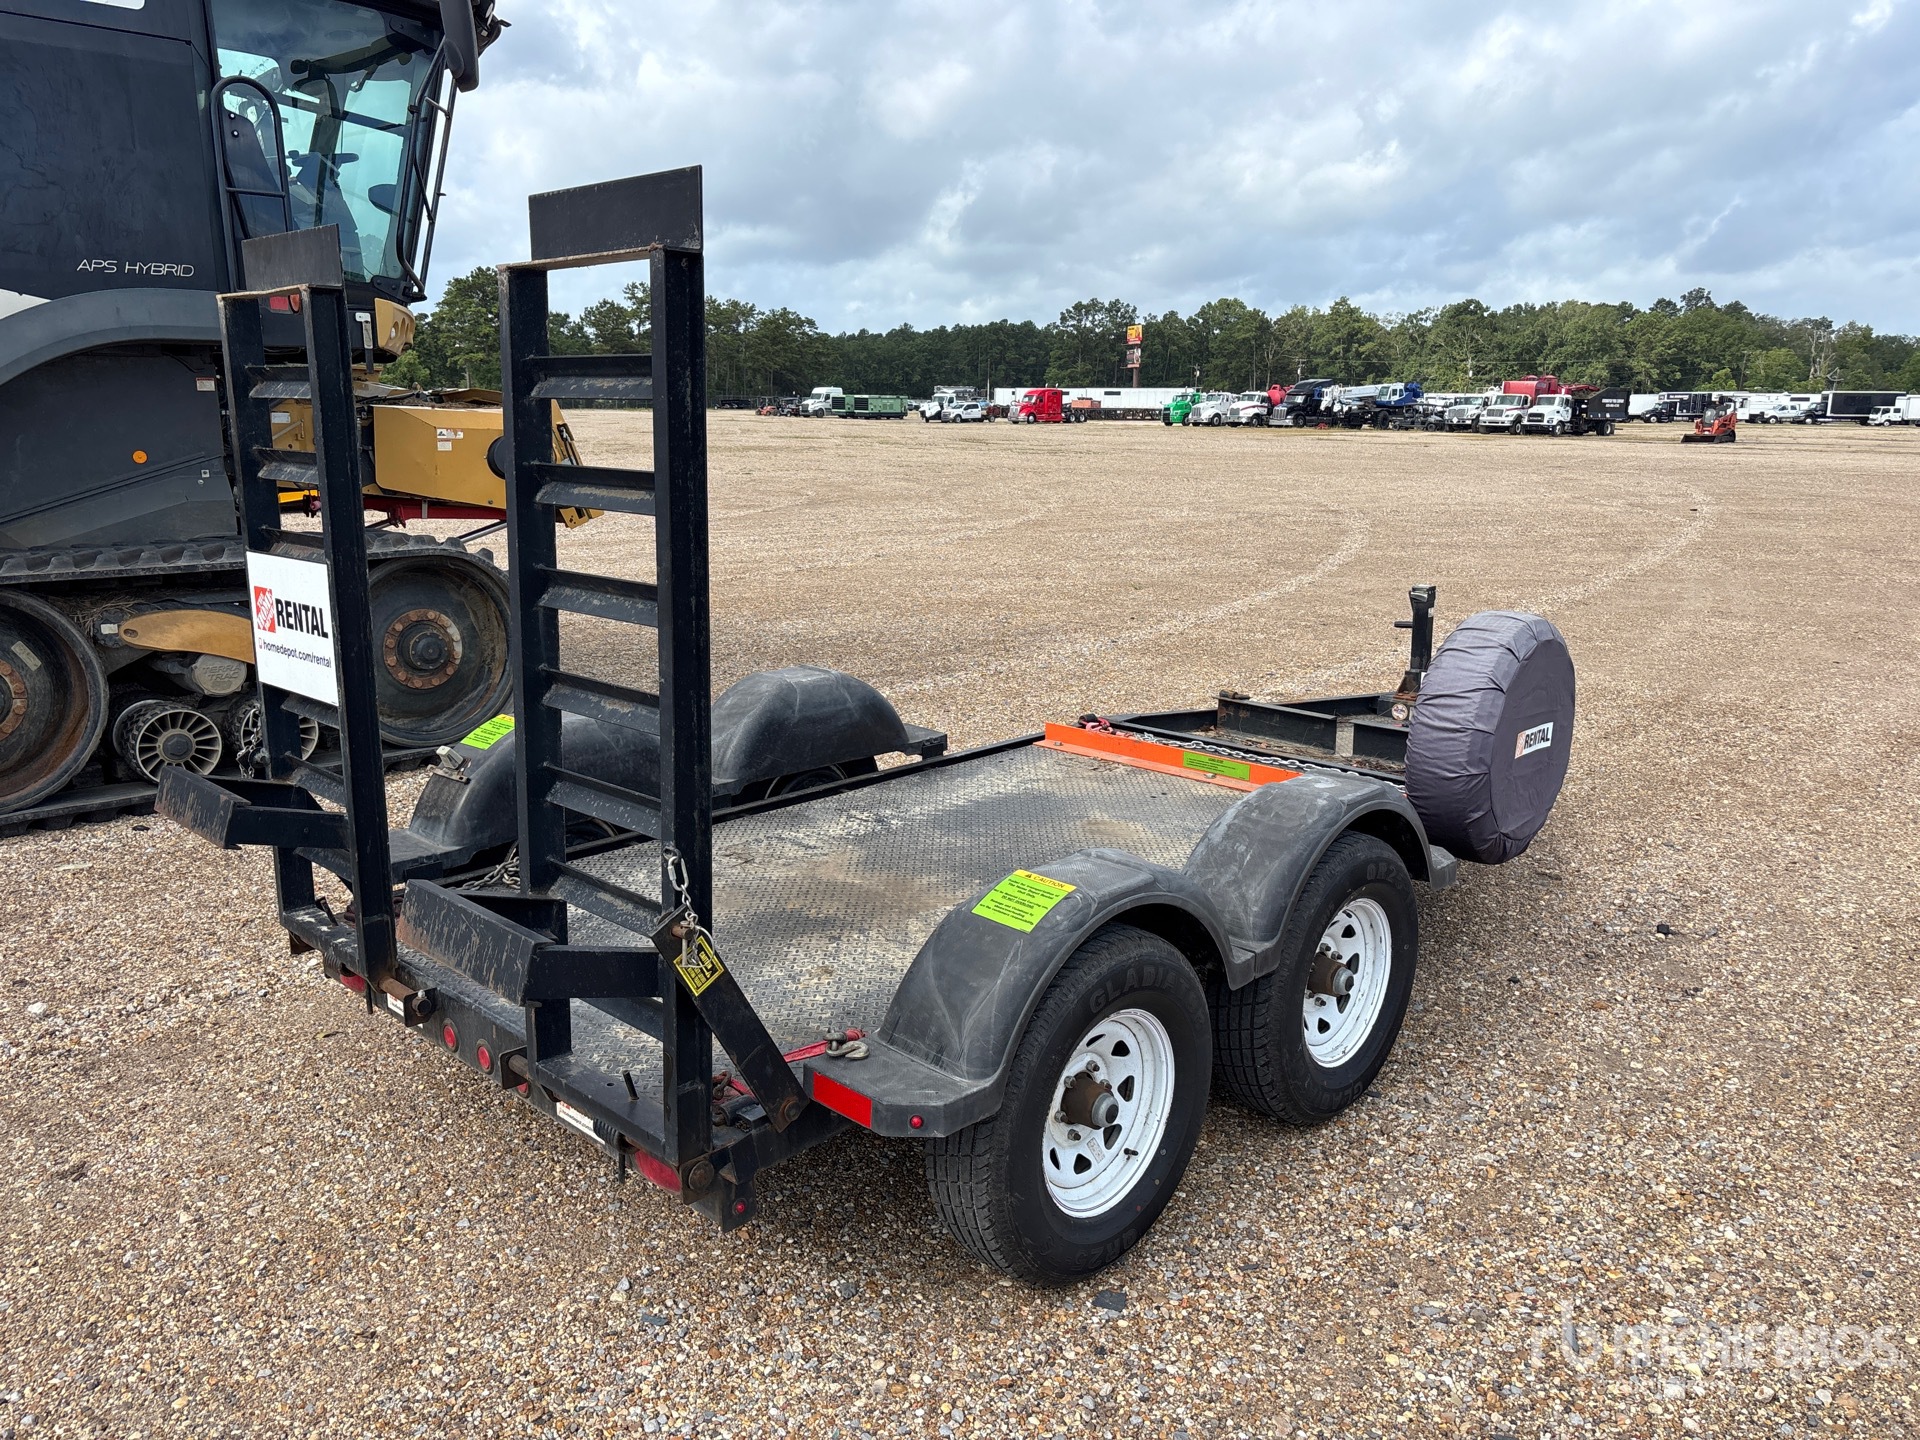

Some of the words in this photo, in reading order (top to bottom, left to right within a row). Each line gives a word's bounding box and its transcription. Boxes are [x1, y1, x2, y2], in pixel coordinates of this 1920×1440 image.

[77, 259, 118, 272] APS
[125, 261, 194, 277] HYBRID
[275, 597, 329, 639] RENTAL
[263, 639, 332, 668] homedepot.com/rental
[202, 664, 242, 674] TERRA
[208, 671, 239, 681] TRAC
[1524, 727, 1550, 750] RENTAL
[1034, 875, 1065, 889] CAUTION
